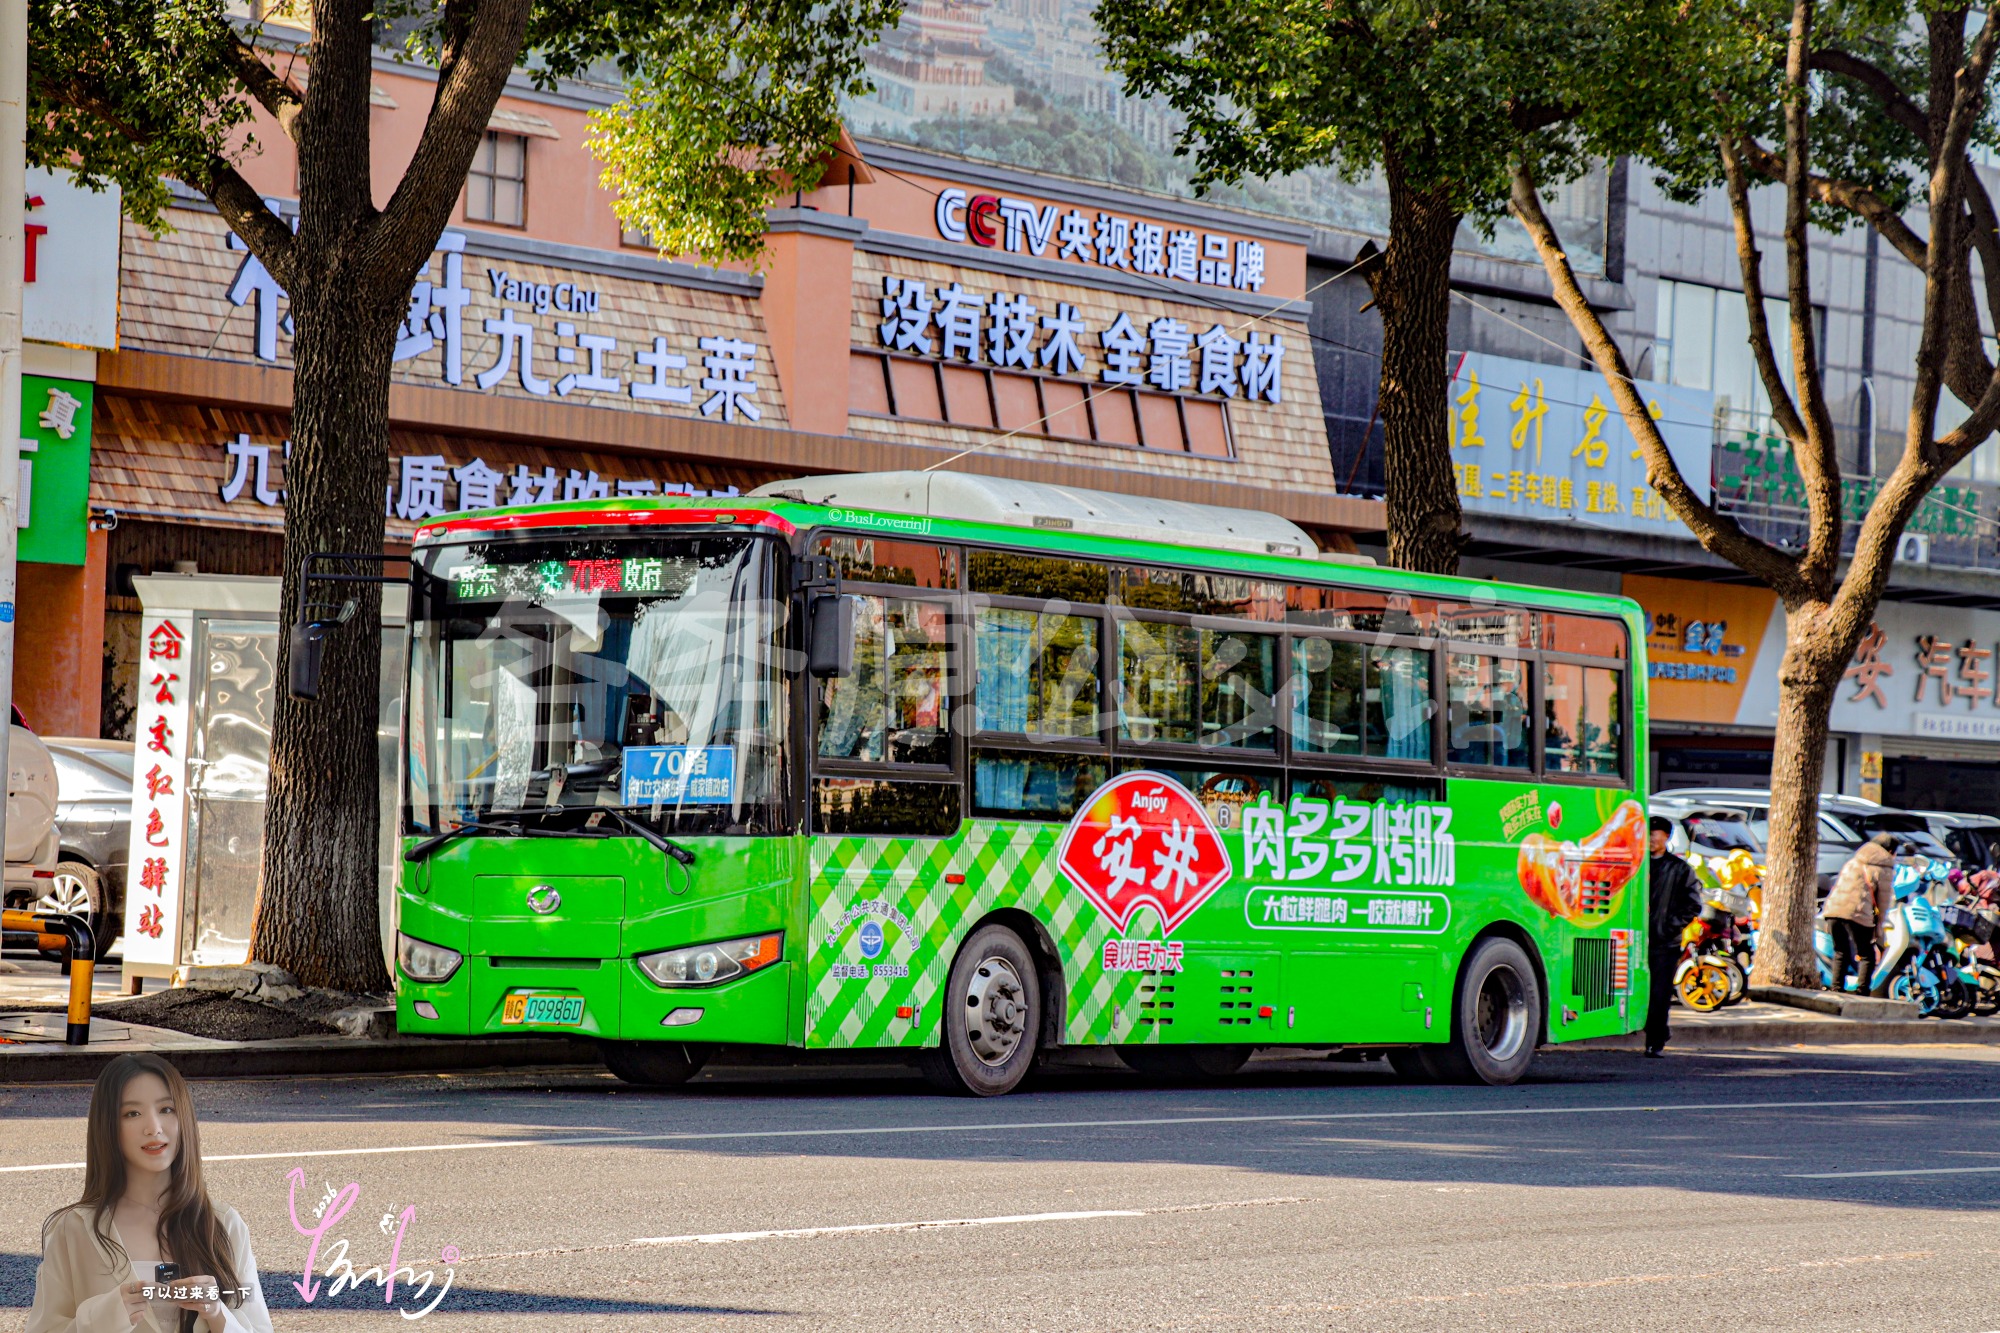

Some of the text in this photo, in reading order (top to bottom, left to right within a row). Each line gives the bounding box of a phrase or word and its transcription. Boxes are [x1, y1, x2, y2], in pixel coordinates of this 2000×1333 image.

[936, 188, 1265, 292] CCTV央视报道品牌
[487, 268, 601, 313] Yang Chu
[475, 308, 762, 422] 九江土菜
[881, 276, 1288, 404] 没有技术 全靠食材
[1914, 635, 2000, 710] 汽车
[650, 750, 708, 776] 70路
[137, 672, 179, 940] 公交红色驿站
[1131, 786, 1168, 813] Anjoy
[1093, 815, 1199, 904] 安井
[1243, 795, 1456, 887] 肉多多烤肠
[826, 900, 921, 951] 九江市公共交通集团公司
[1263, 895, 1434, 927] 大粒鲜腿肉 一咬就爆汁
[873, 965, 909, 978] 8553416
[1102, 941, 1184, 972] 食以民为天
